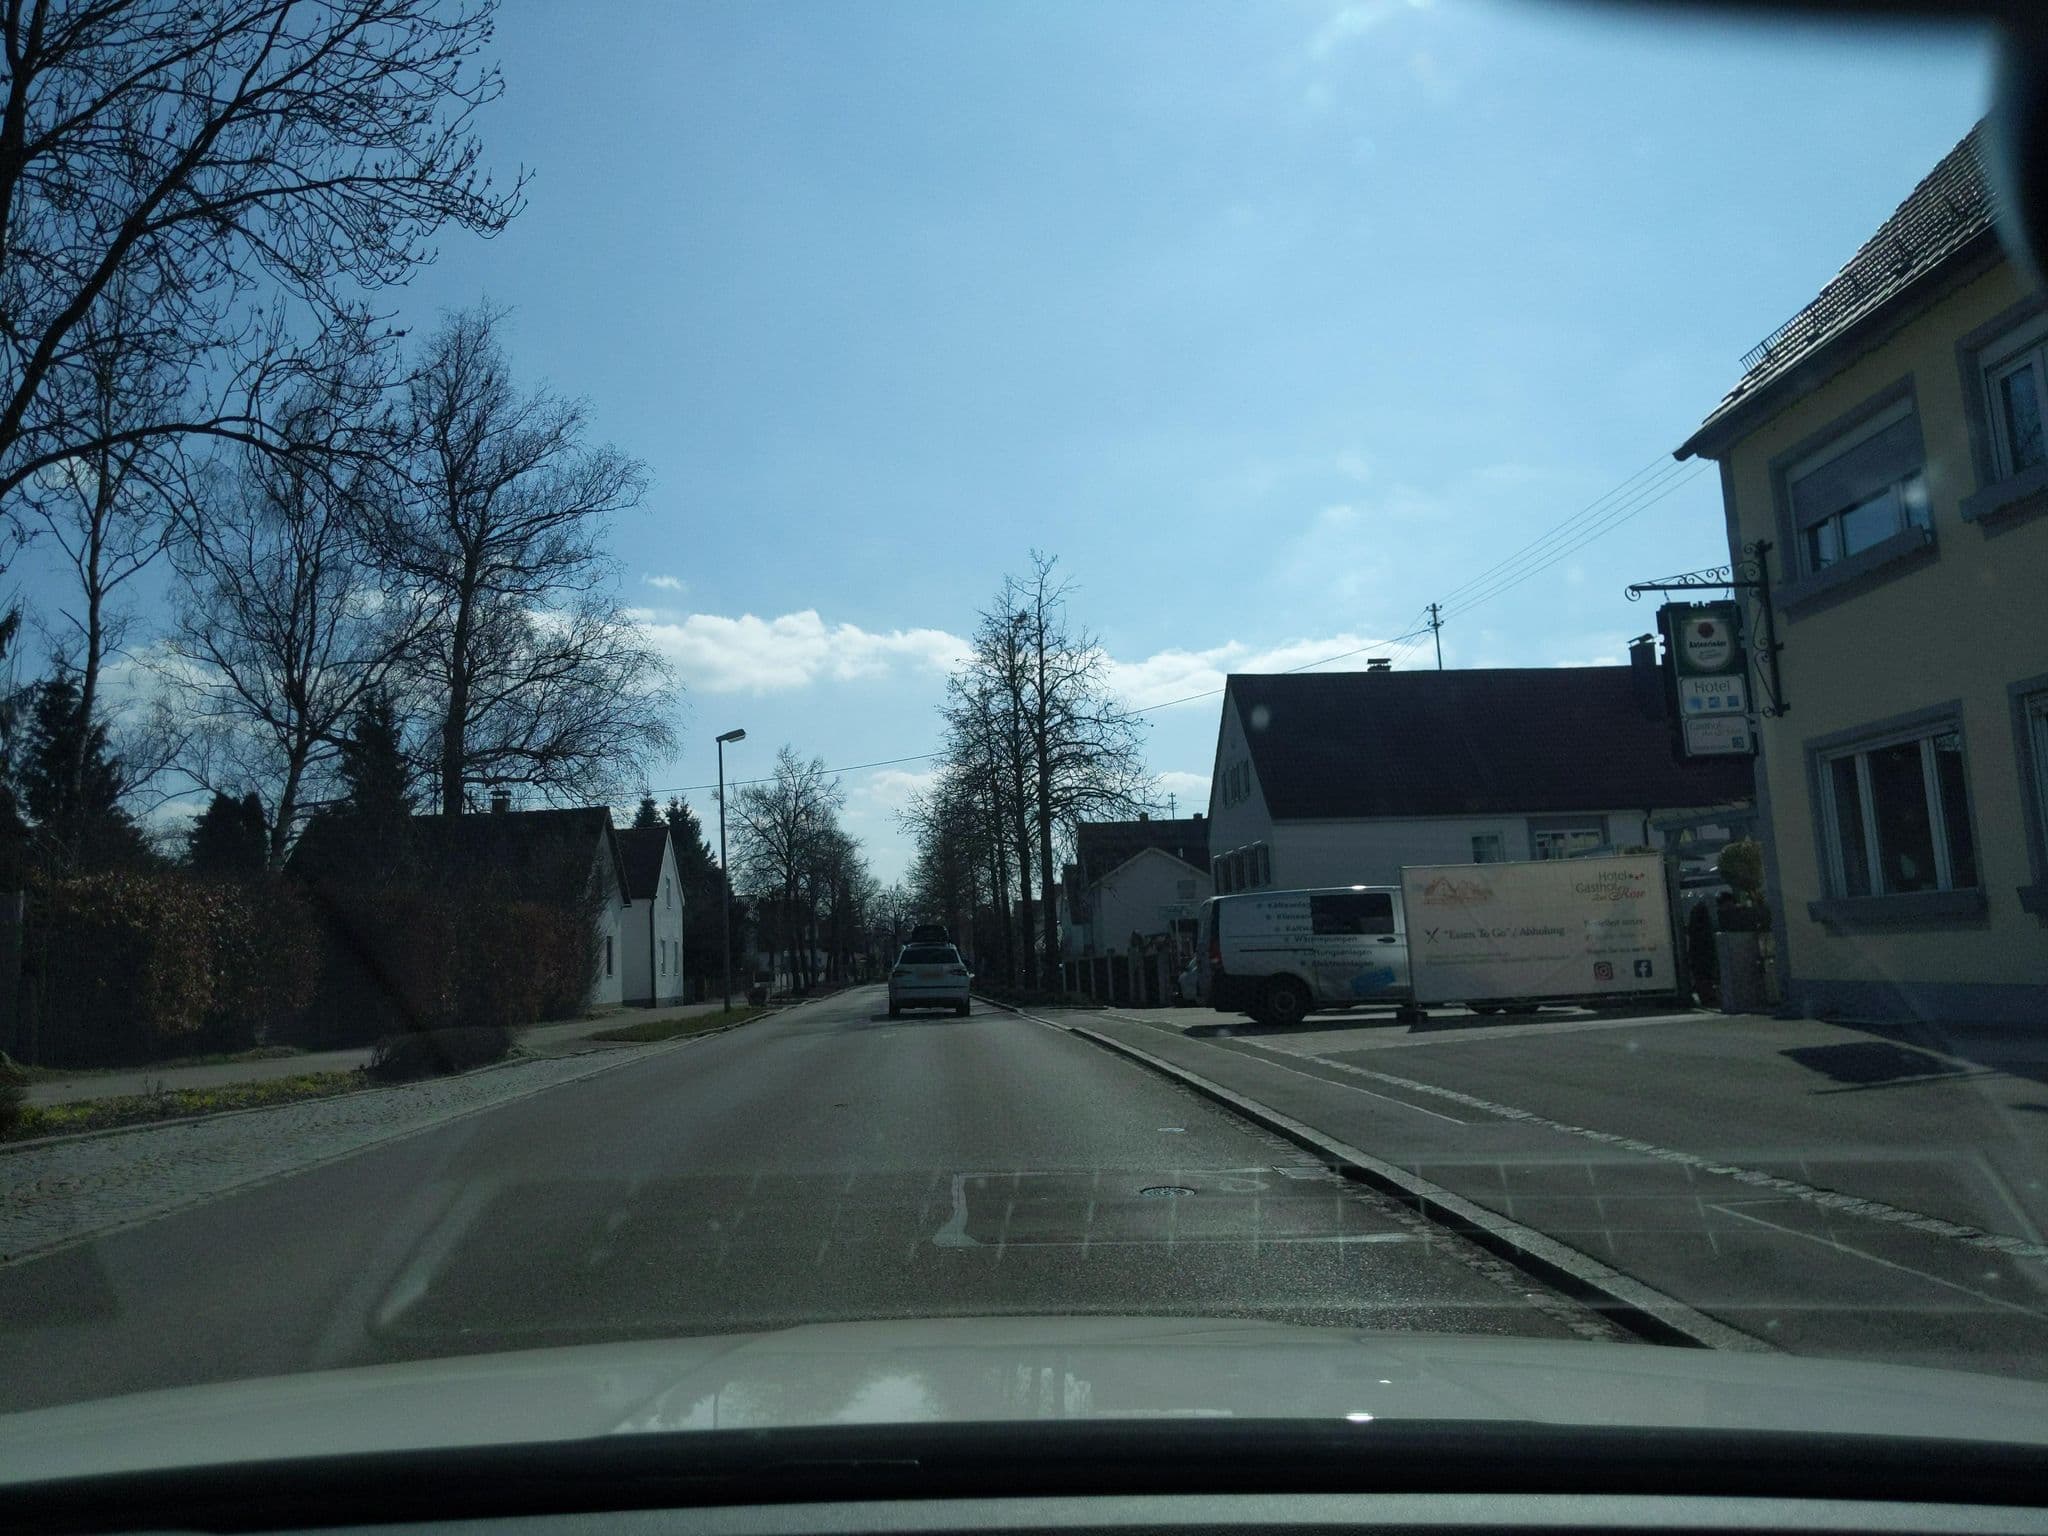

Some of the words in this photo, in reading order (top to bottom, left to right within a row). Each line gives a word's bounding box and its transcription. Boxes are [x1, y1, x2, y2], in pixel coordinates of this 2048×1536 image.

[1695, 680, 1731, 693] Hotel
[1598, 871, 1627, 881] Hotel
[1575, 881, 1617, 894] Gasthof
[1519, 926, 1566, 937] Abholung
